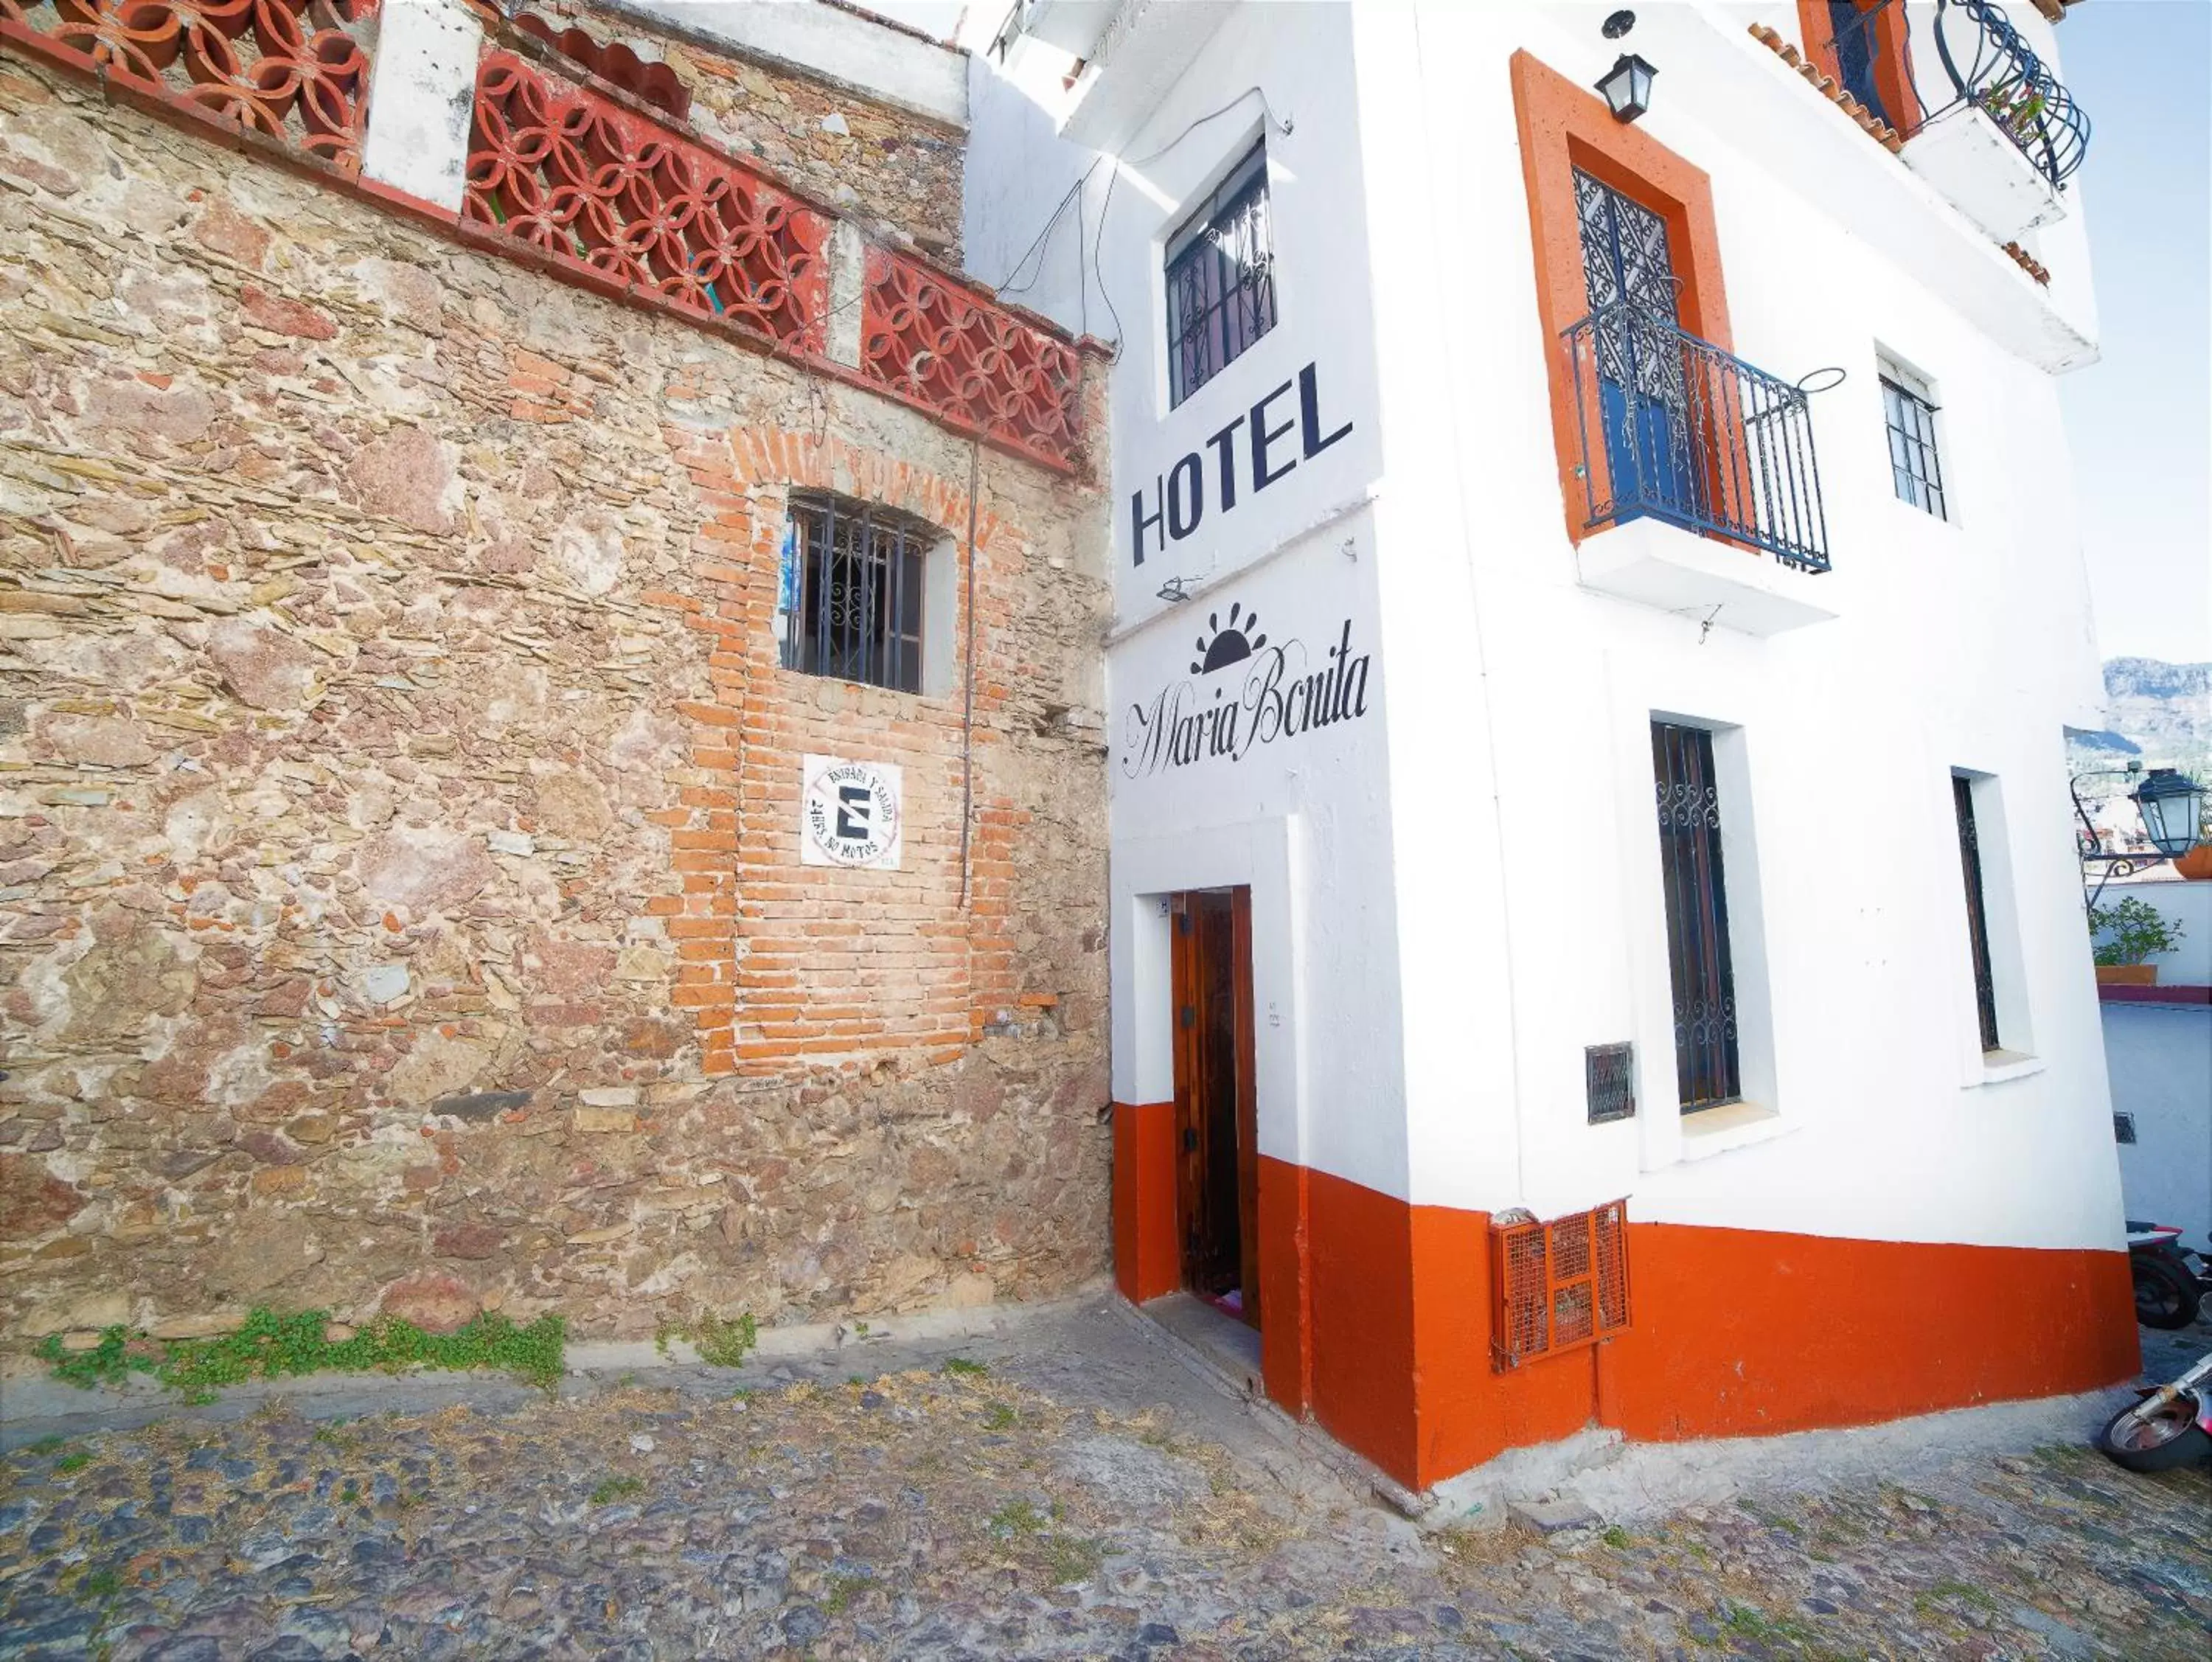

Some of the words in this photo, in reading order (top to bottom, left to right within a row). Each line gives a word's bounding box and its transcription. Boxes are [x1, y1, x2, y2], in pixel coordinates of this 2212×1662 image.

[1132, 361, 1353, 569] HOTEL
[1121, 679, 1239, 779] Maria
[1233, 619, 1370, 762] Bonita
[824, 836, 839, 851] NO
[841, 841, 877, 858] MOTOS
[827, 767, 866, 783] ENTRADA
[870, 776, 878, 788] Y
[874, 786, 893, 822] SALIDA
